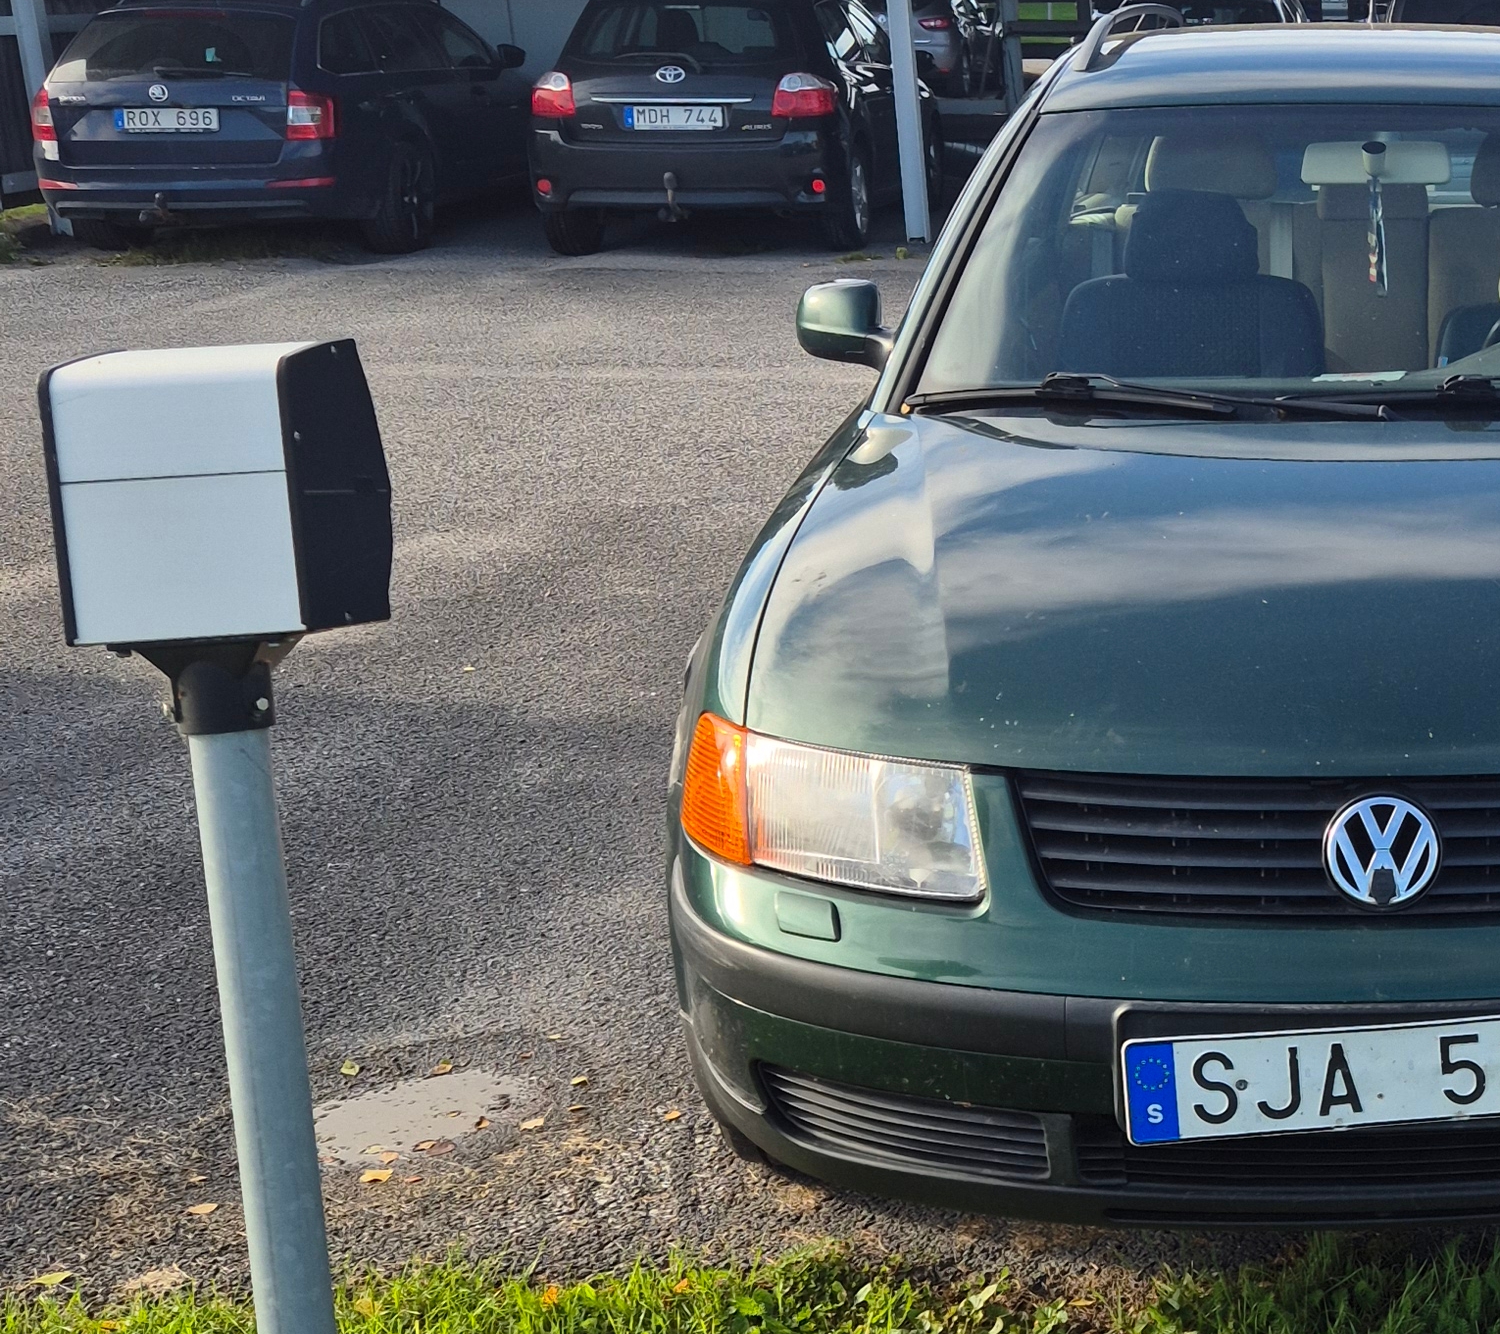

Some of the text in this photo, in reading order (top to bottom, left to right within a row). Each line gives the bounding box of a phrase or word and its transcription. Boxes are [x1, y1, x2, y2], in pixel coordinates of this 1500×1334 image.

[126, 110, 213, 127] ROX 696
[636, 108, 718, 124] MDH 744
[1192, 1042, 1363, 1124] SJA
[1147, 1103, 1164, 1124] S
